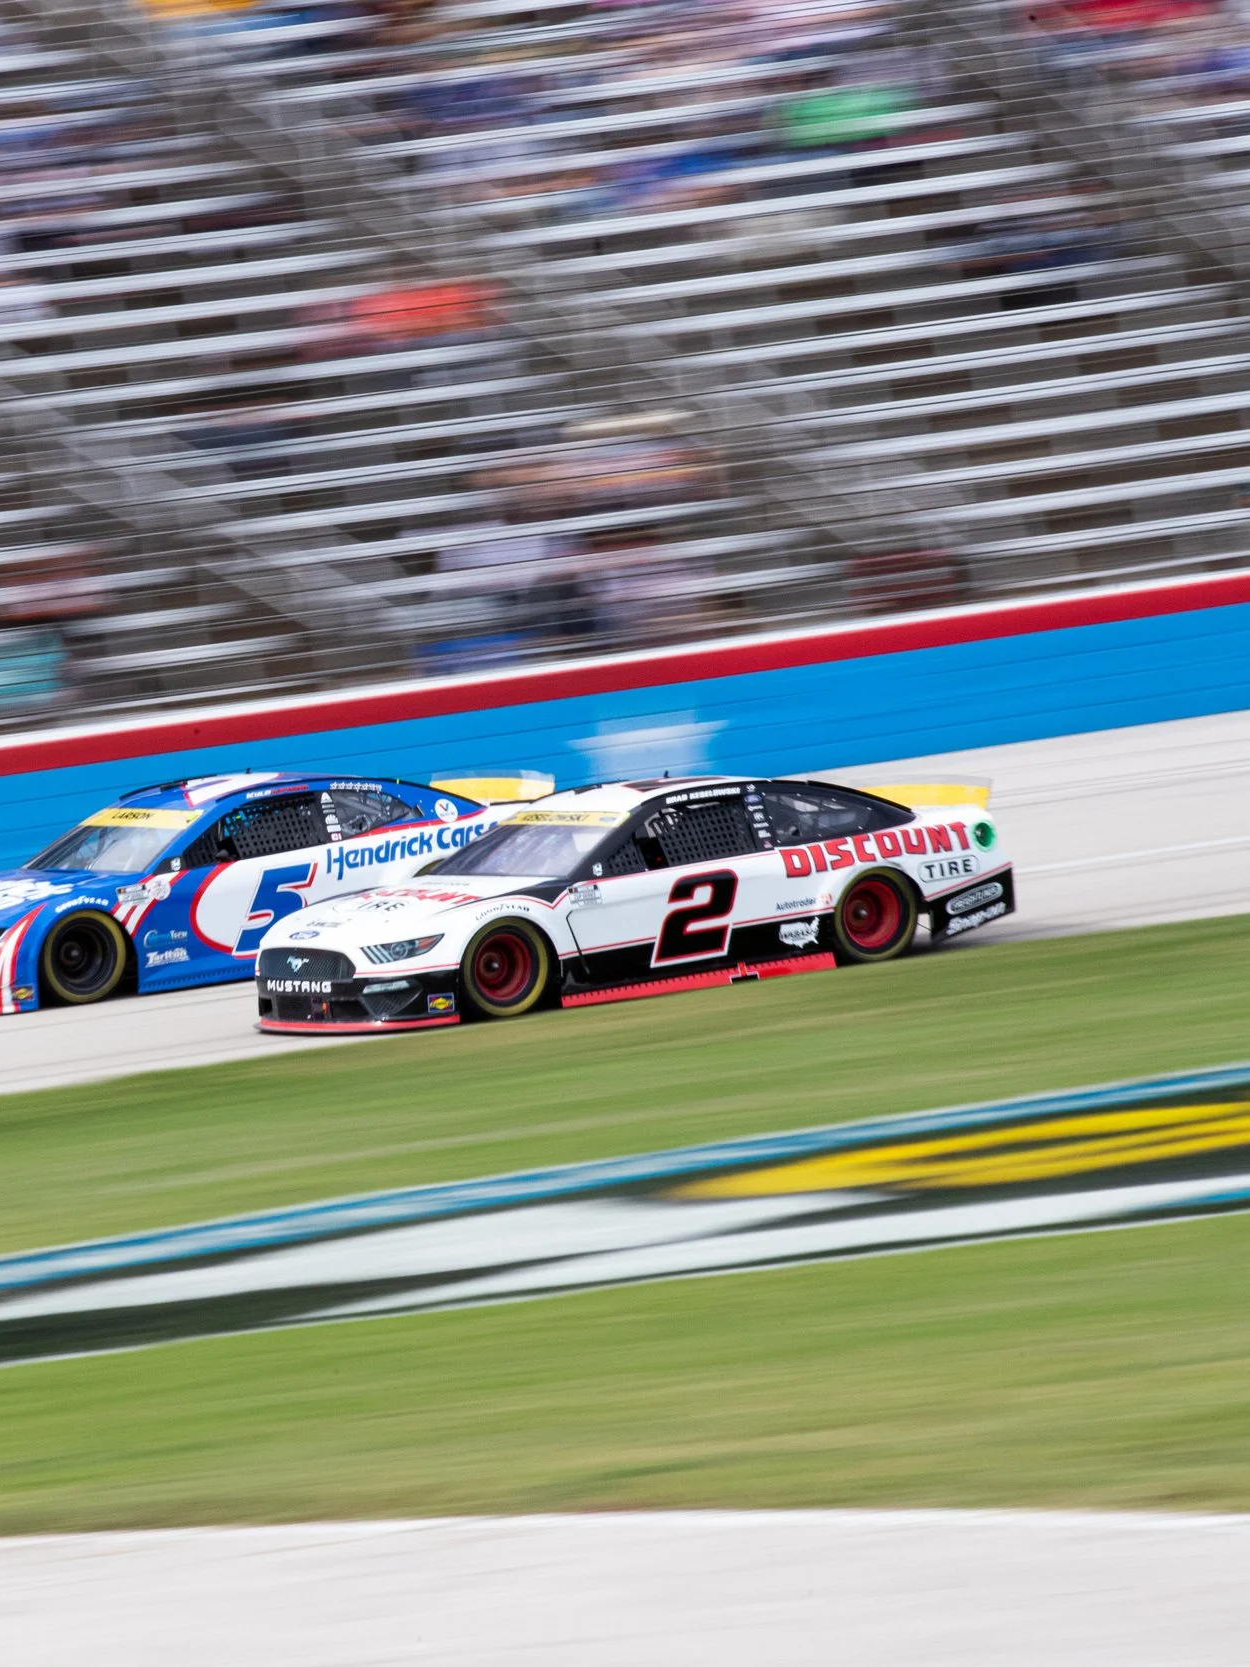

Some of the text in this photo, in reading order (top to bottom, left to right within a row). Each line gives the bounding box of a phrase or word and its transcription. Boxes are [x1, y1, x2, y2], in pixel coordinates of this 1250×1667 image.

[666, 787, 741, 804] BRAD KESELOWSKI
[326, 832, 433, 880] Hendrick
[780, 821, 971, 878] DISCOUNT
[925, 859, 973, 878] TIRE
[232, 860, 316, 957] 5
[651, 868, 739, 968] 2
[267, 979, 332, 993] MUSTANG
